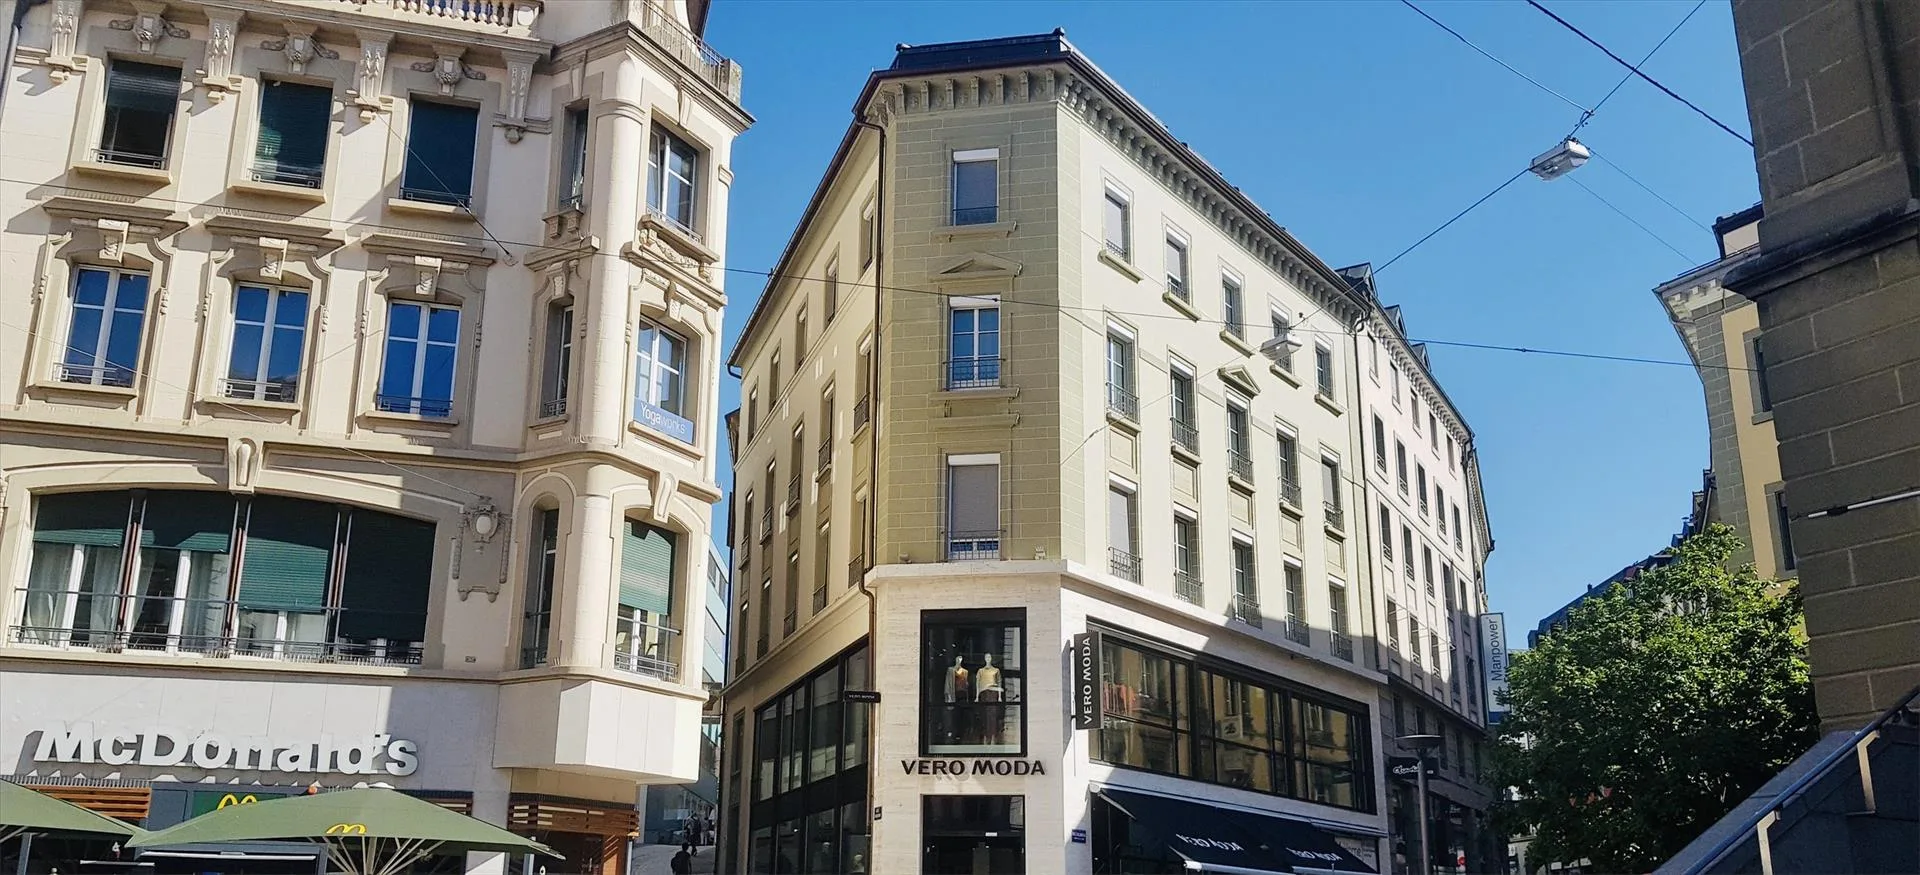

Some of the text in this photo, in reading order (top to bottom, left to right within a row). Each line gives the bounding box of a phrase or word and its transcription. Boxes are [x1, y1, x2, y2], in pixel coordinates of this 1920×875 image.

[1488, 619, 1504, 682] Manpower
[1082, 637, 1093, 725] VERO MODA
[33, 721, 418, 776] McDonald's
[900, 760, 1046, 776] VERO MODA
